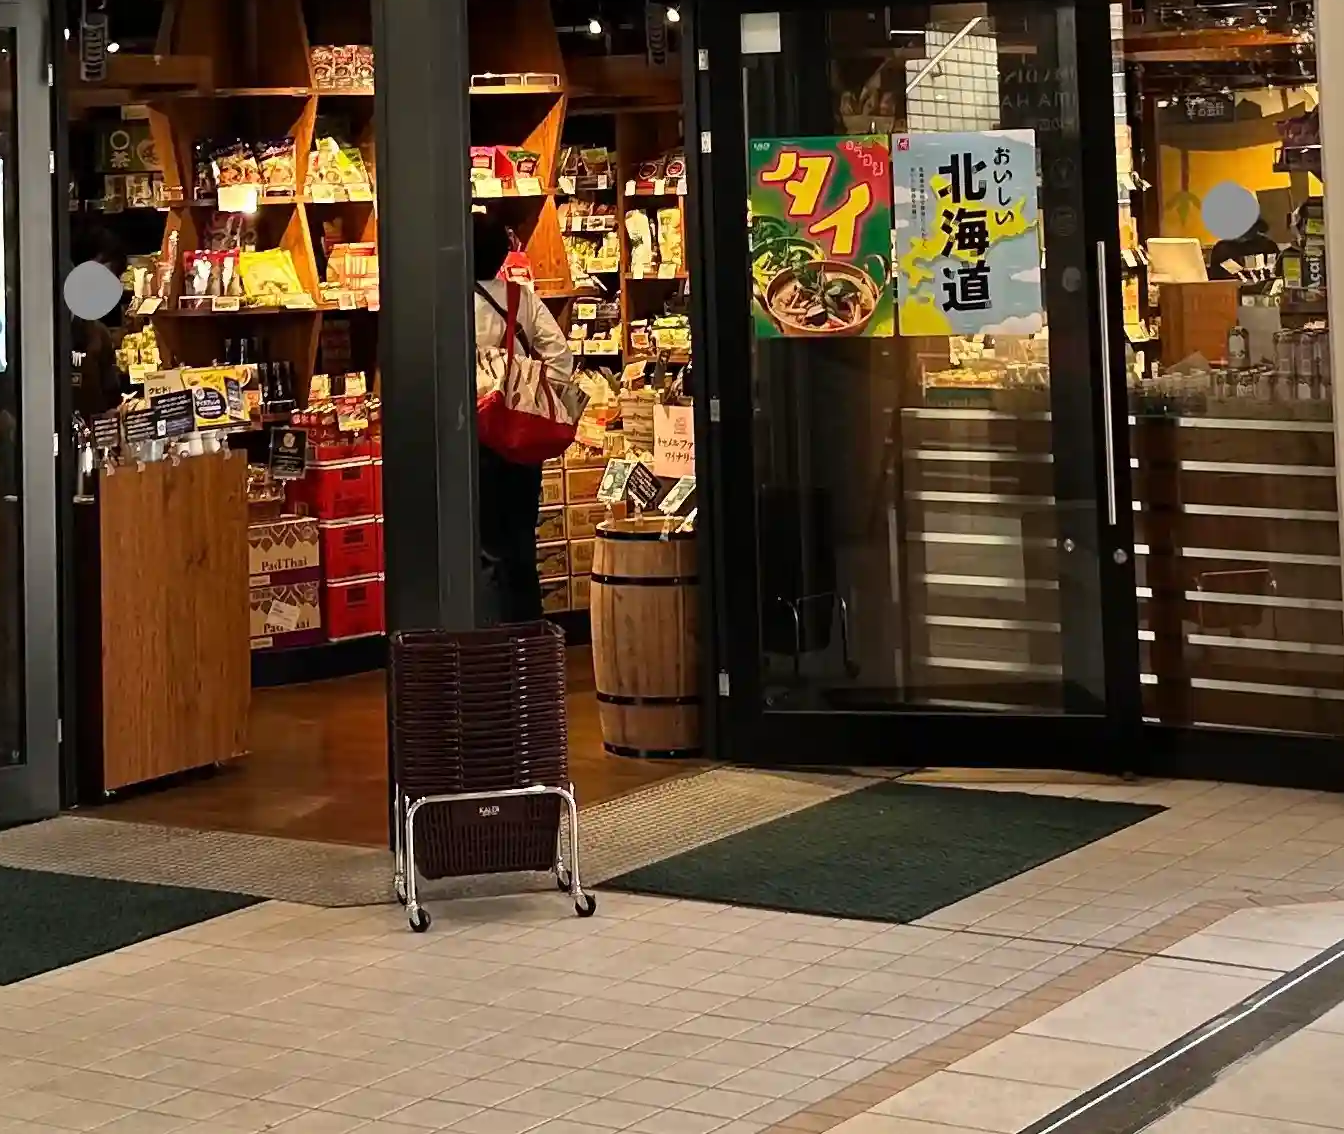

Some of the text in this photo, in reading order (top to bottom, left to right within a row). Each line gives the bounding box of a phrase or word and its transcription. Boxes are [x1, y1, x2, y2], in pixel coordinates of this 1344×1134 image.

[761, 151, 872, 255] タイ
[937, 152, 992, 313] 北海道
[993, 146, 1015, 226] おいしい
